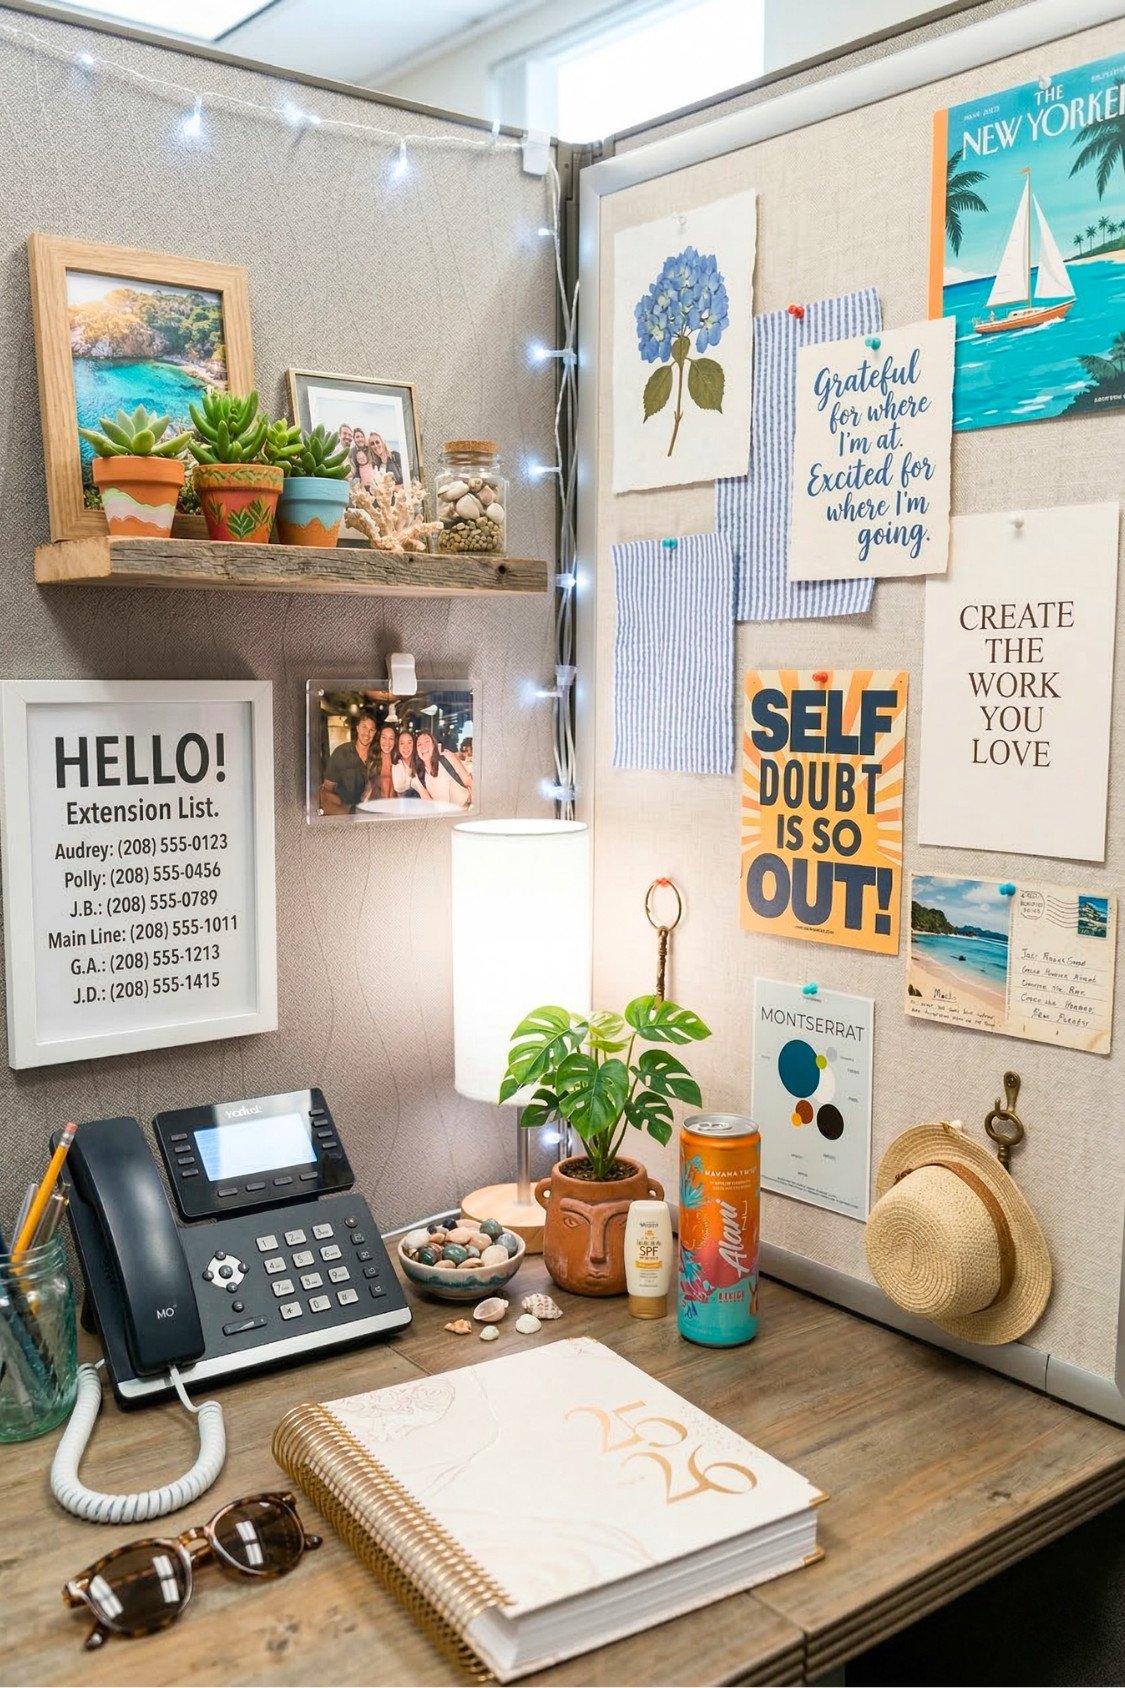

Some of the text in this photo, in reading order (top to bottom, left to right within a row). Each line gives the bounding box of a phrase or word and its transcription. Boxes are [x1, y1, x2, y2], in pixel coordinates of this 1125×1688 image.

[1034, 84, 1064, 106] THE
[962, 115, 1022, 161] NEW
[814, 349, 921, 411] Grateful
[830, 391, 932, 434] for where
[839, 422, 904, 456] I'm at.
[807, 452, 936, 496] Excited for
[827, 490, 929, 522] where I'm
[858, 521, 931, 561] going.
[959, 601, 1075, 631] CREATE
[985, 637, 1044, 664] THE
[968, 672, 1061, 699] WORK
[751, 688, 898, 755] SELF
[980, 706, 1044, 732] YOU
[54, 733, 226, 789] HELLO!
[972, 739, 1051, 767] LOVE
[760, 758, 882, 815] DOUBT
[66, 796, 220, 826] Extension List.
[55, 833, 228, 864] Audrey: (208) 555-0123
[777, 814, 862, 857] IS SO
[65, 861, 221, 892] Polly: (208) 555-0456
[70, 890, 218, 918] J.B.: (208) 555-0789
[747, 852, 893, 936] OUT!
[48, 915, 238, 950] Main Line: (208) 555-1011
[71, 944, 220, 976] G.A.: (208) 555-1213
[73, 972, 220, 1005] J.D.: (208) 555-1415
[761, 1006, 865, 1041] MONTSERRAT
[639, 1245, 659, 1257] SPF
[715, 1199, 750, 1279] Alani
[156, 1307, 175, 1320] MO
[564, 1400, 688, 1453] 25
[620, 1444, 758, 1505] 26
